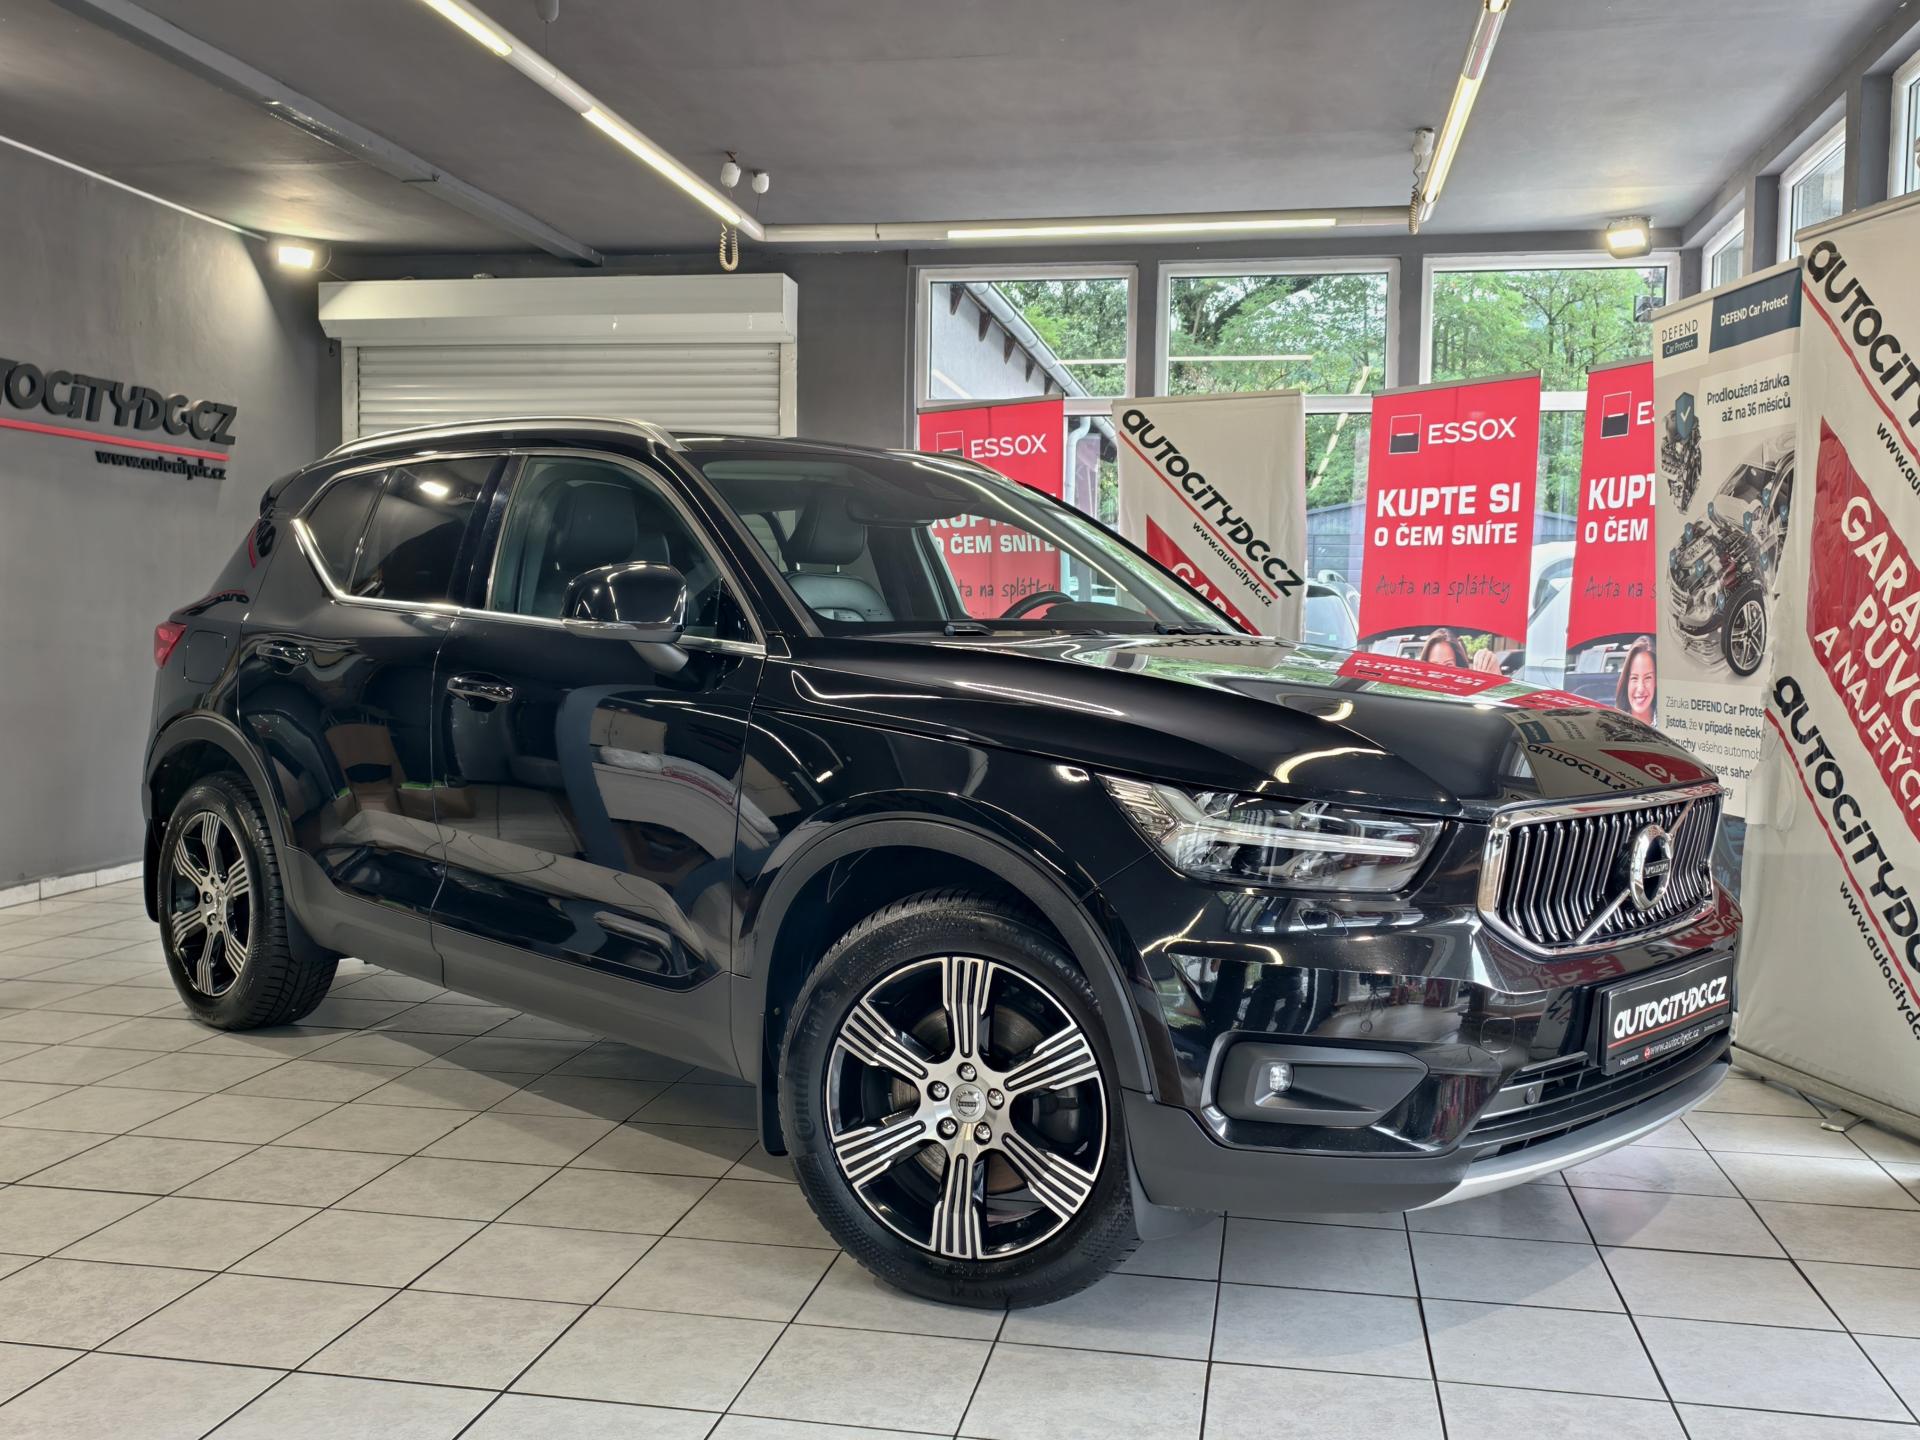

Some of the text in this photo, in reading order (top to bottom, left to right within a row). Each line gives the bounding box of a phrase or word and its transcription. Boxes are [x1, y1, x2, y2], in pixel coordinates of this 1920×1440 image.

[1720, 294, 1788, 327] DEFEND Car Protect
[1662, 319, 1698, 342] DEFEND
[1707, 373, 1790, 405] Prodloužená záruka
[1721, 391, 1791, 422] až na 36 měsíců
[1427, 417, 1517, 445] ESSOX
[970, 433, 1048, 460] ESSOX
[1376, 482, 1521, 518] KUPTE SI
[950, 533, 992, 554] ČEM
[1374, 519, 1519, 547] O ČEM SNÍTE
[1585, 517, 1648, 543] O ČEM
[1193, 521, 1273, 608] www.autocitydc.cz
[979, 584, 994, 598] na
[1376, 574, 1512, 605] Auta na splátky
[1584, 576, 1621, 598] Auta
[1627, 582, 1644, 597] na
[1815, 626, 1840, 658] A
[1666, 696, 1689, 710] Záruka
[1690, 698, 1722, 713] DEFEND
[1723, 703, 1737, 715] Car
[1689, 718, 1697, 730] že
[1704, 721, 1733, 736] případě
